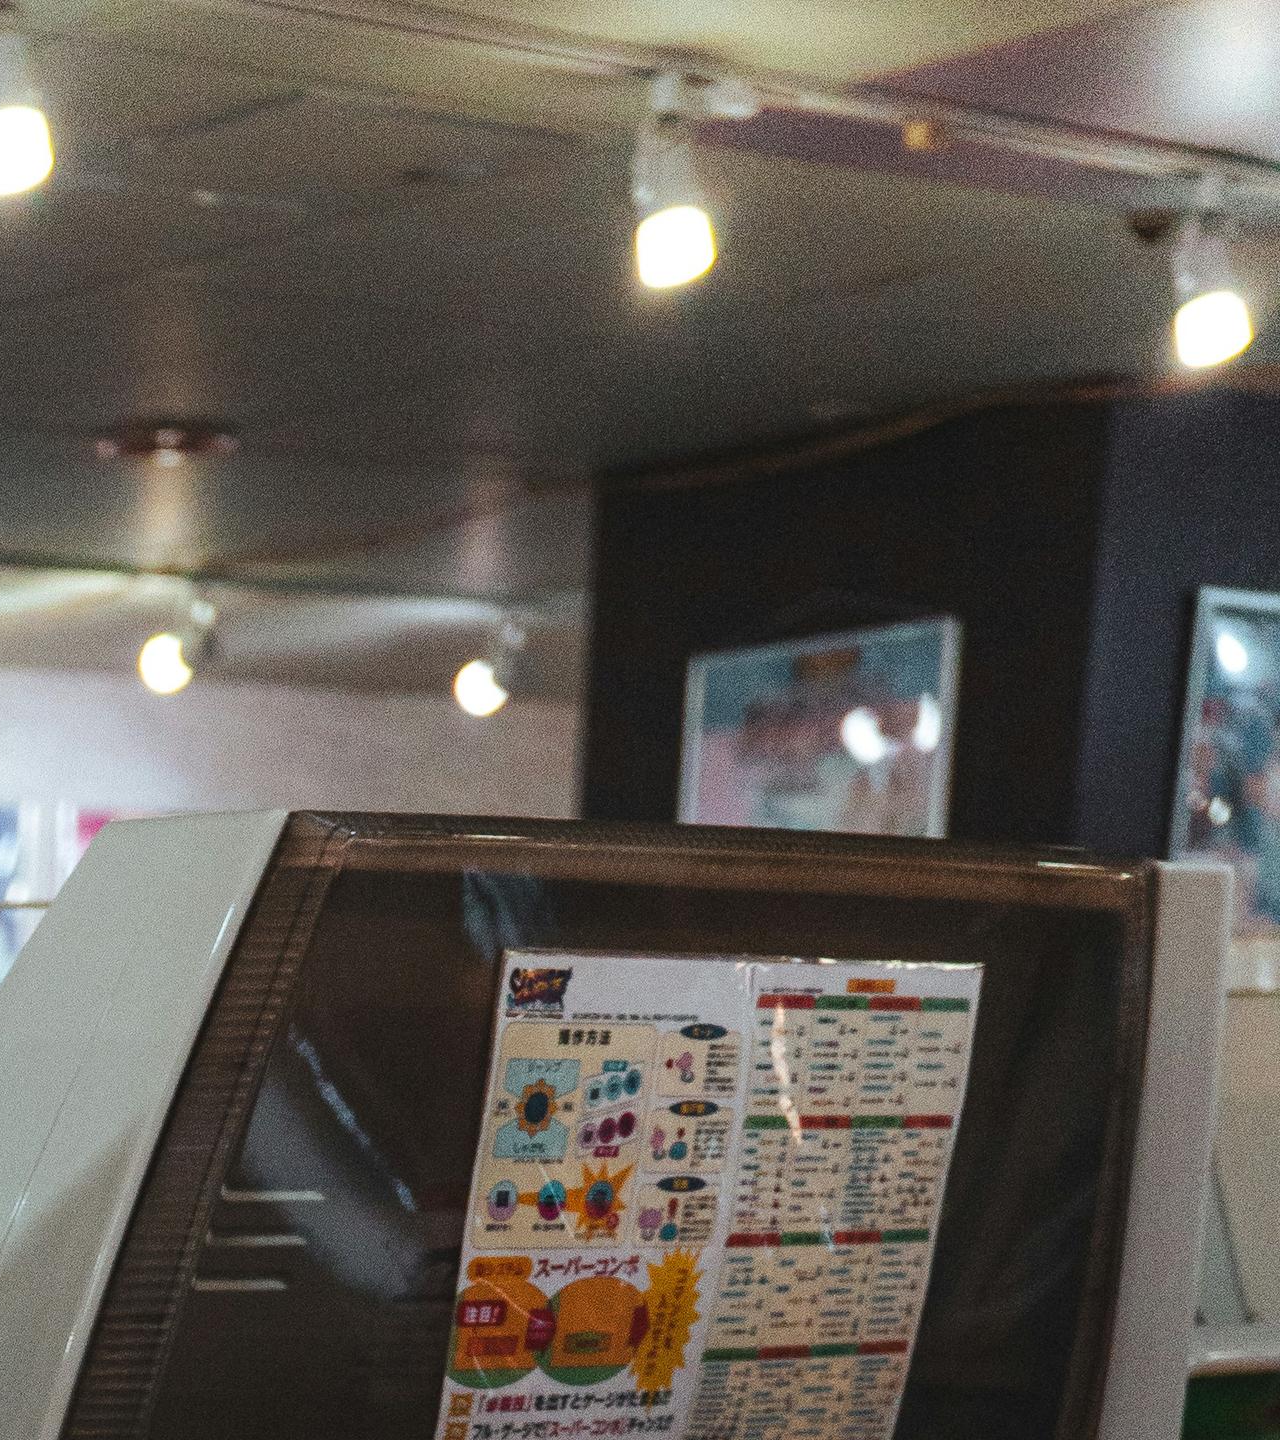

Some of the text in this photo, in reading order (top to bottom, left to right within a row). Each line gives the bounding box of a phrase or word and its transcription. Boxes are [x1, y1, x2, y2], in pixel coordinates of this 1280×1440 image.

[534, 1256, 640, 1277] スーパーコンボ
